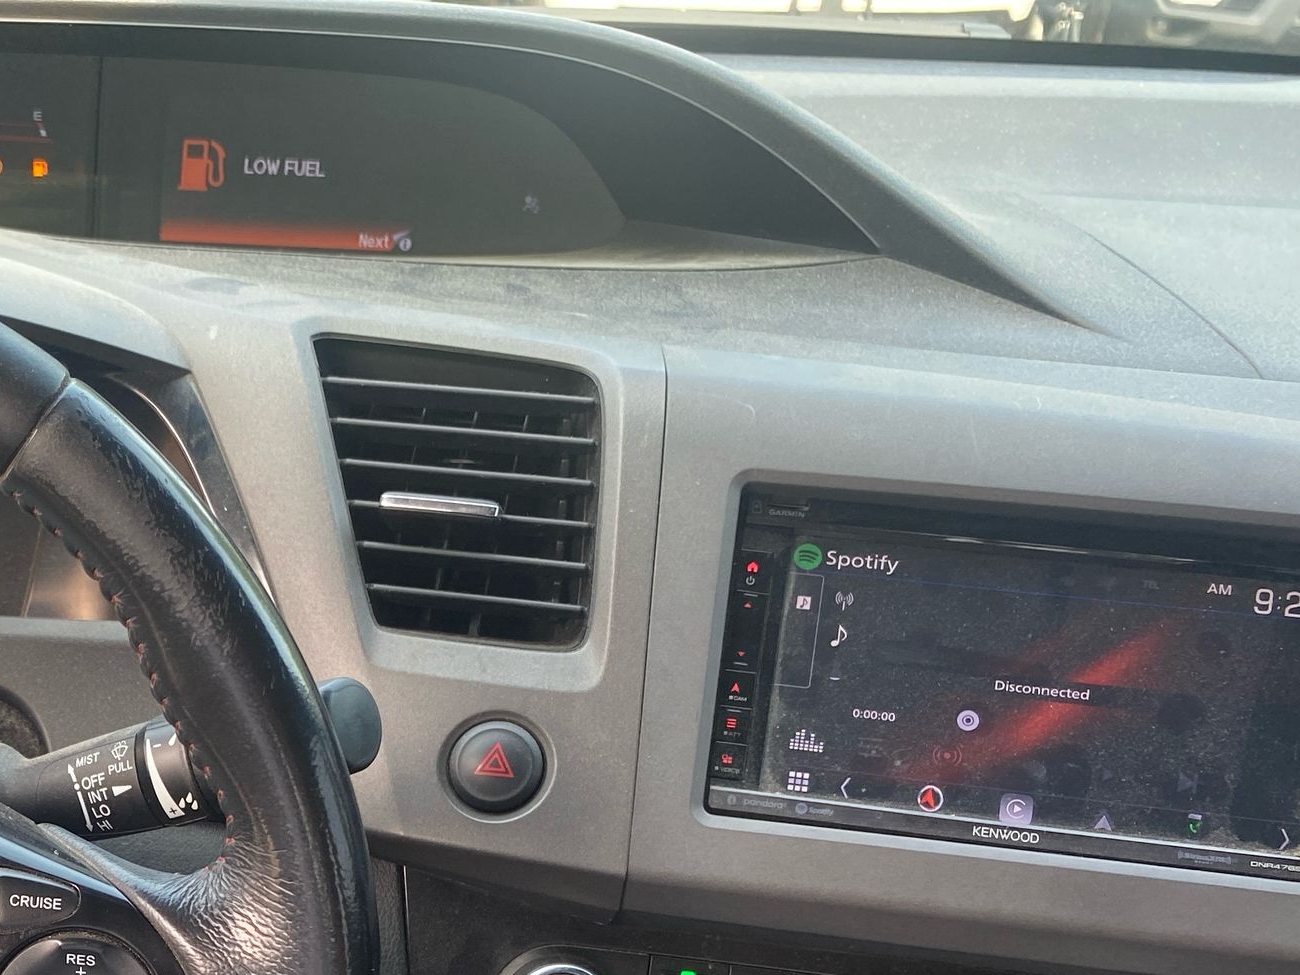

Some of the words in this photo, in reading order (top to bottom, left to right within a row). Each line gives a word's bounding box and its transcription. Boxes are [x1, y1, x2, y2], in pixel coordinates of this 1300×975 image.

[244, 157, 280, 176] LOW
[284, 158, 326, 178] FUEL
[358, 233, 391, 250] Next
[768, 509, 805, 518] GARMIN
[826, 550, 899, 576] Spotify
[1207, 583, 1232, 596] AM
[994, 680, 1090, 700] Disconnected
[852, 708, 896, 722] 0:00:00
[75, 752, 101, 768] MIST
[107, 761, 134, 776] PULL
[81, 772, 106, 791] OFF
[87, 786, 109, 803] INT
[94, 803, 112, 819] LO
[743, 797, 784, 809] pandora
[99, 819, 114, 831] HI
[972, 825, 1040, 844] KENWOOD
[9, 893, 63, 911] CRUISE
[66, 953, 96, 967] RES
